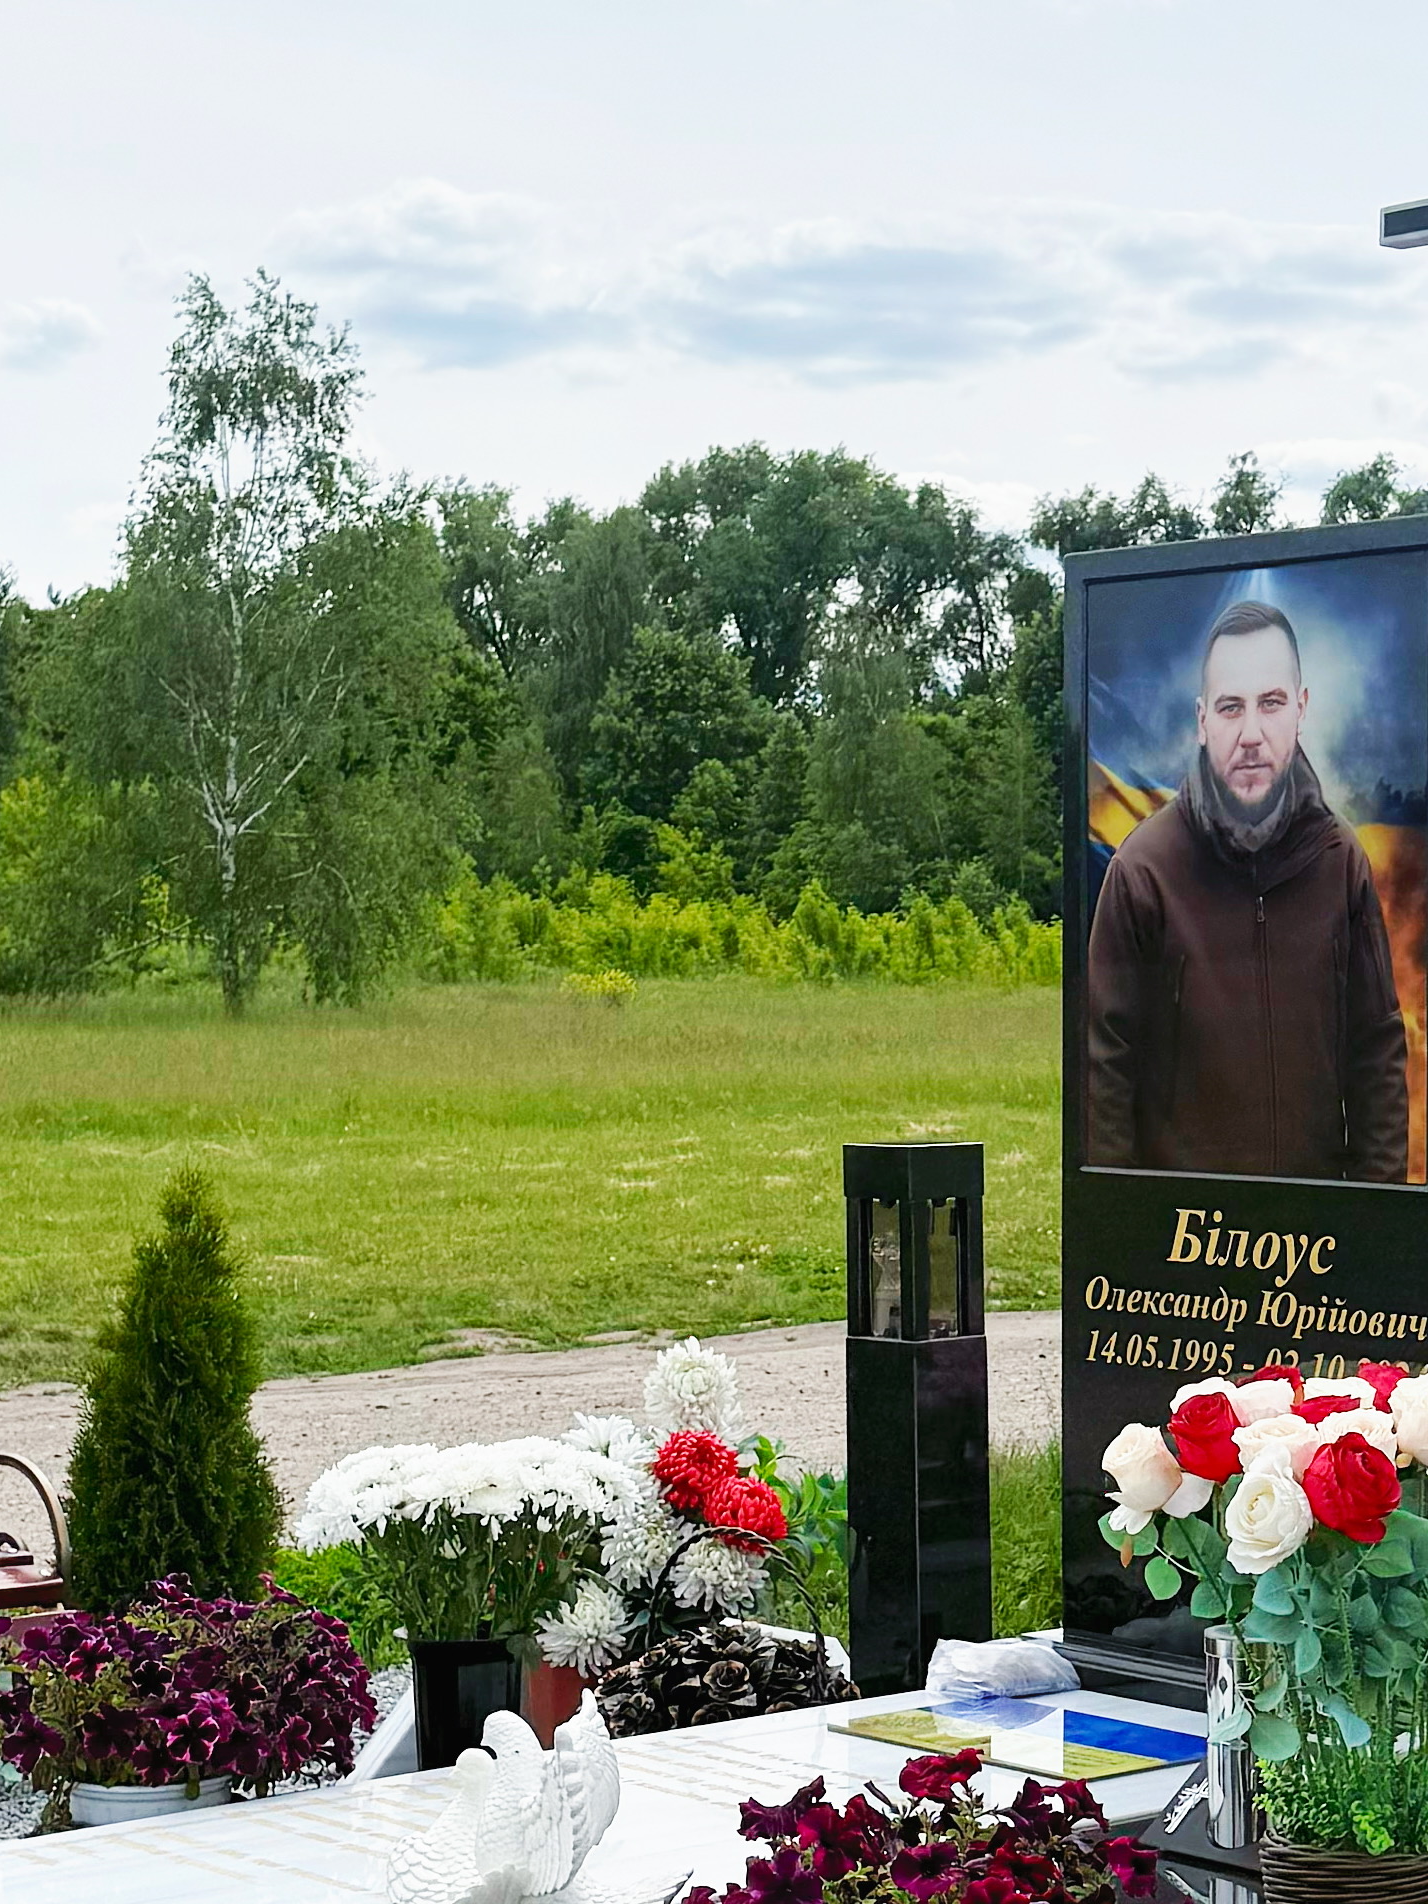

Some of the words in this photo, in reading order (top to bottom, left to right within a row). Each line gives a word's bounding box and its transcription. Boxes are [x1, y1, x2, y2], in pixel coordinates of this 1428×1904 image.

[1166, 1207, 1337, 1288] Білоус
[1085, 1276, 1248, 1333] Олександр
[1256, 1289, 1428, 1343] Юрійович
[1085, 1330, 1235, 1376] 14.05.1995
